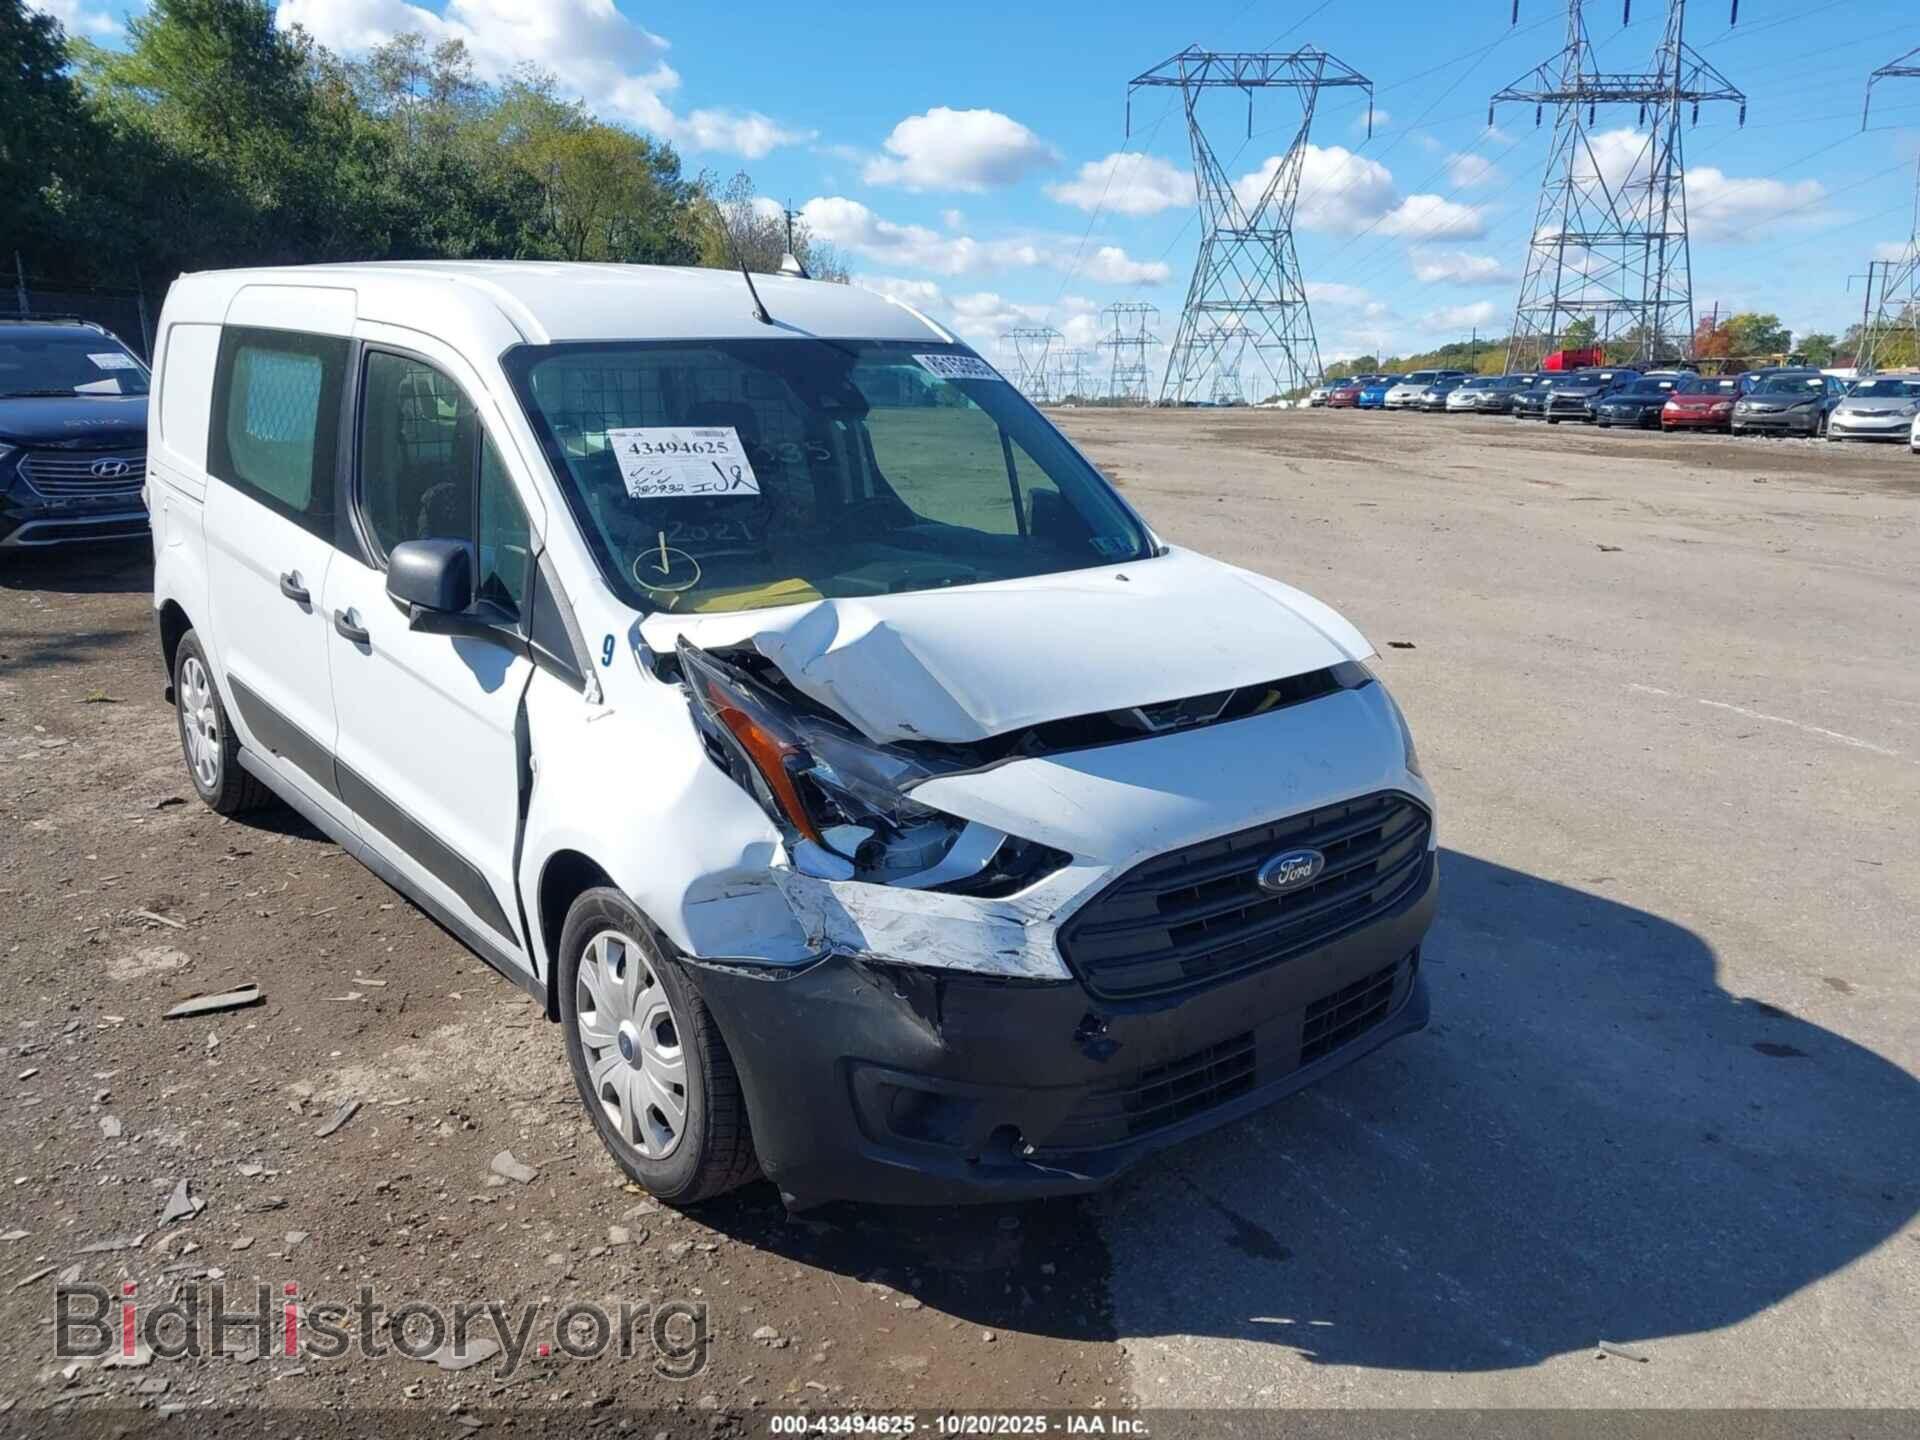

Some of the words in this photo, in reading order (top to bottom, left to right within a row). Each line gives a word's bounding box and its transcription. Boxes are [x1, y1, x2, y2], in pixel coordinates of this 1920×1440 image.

[629, 441, 728, 455] 43494625
[667, 521, 758, 543] 2021
[602, 634, 615, 667] 9
[1278, 857, 1312, 884] Ford
